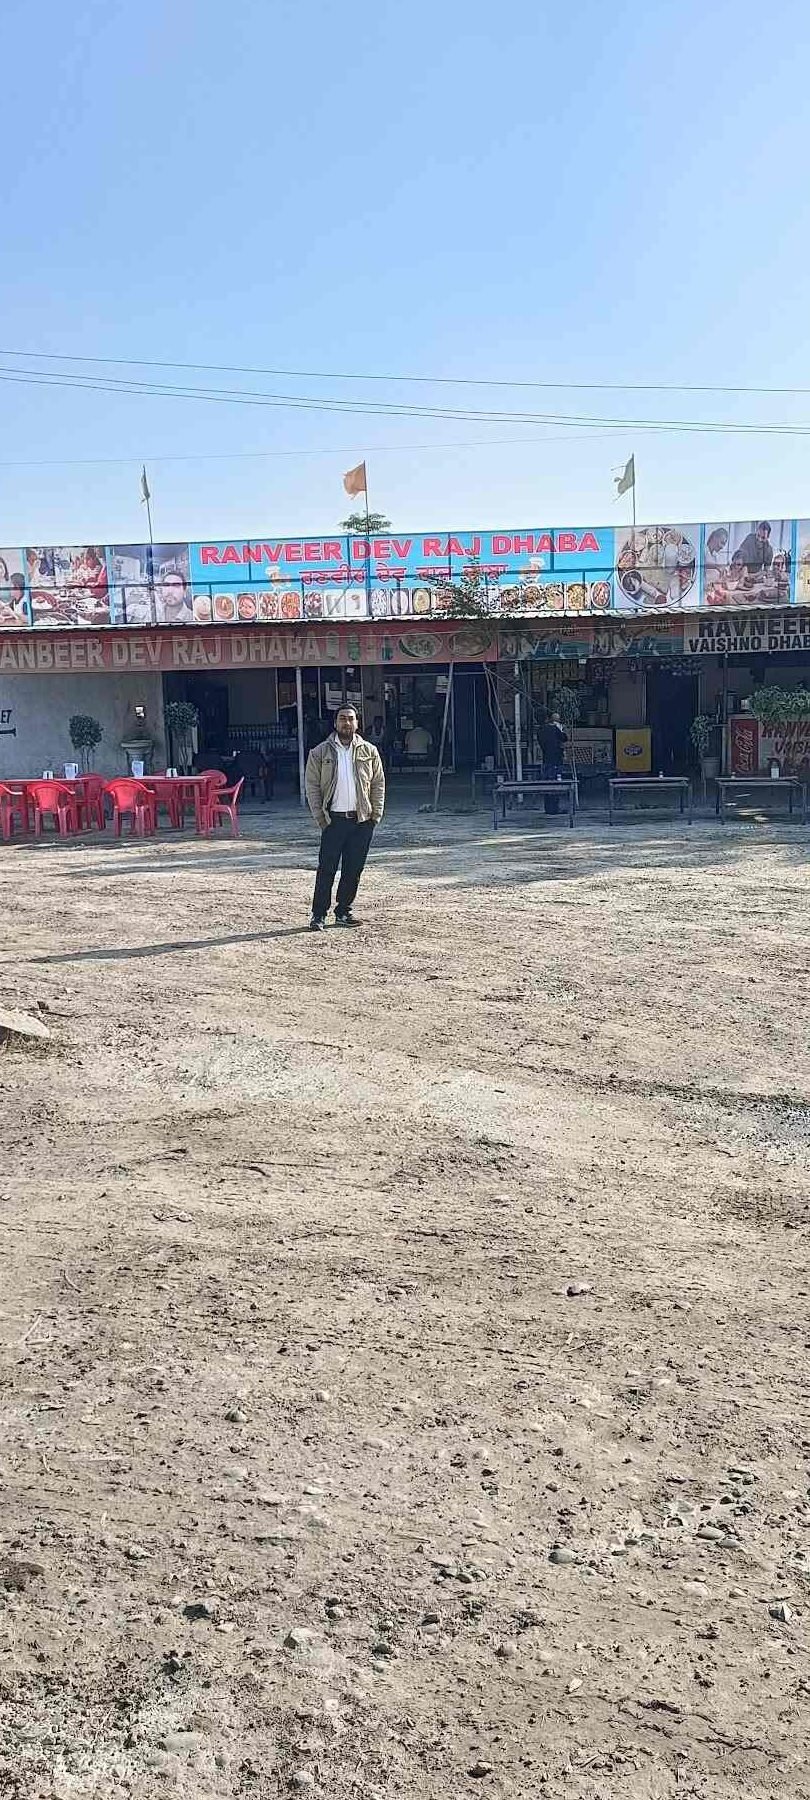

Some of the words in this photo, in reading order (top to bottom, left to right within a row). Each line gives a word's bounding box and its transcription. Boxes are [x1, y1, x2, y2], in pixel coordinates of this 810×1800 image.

[201, 541, 343, 565] RANVEER
[352, 539, 413, 560] DEV
[423, 536, 481, 557] RAJ
[492, 532, 600, 555] DHABA
[111, 636, 163, 666] DEV
[172, 633, 222, 665] RAJ
[230, 631, 323, 663] DHABA
[689, 636, 762, 653] VAISHNO
